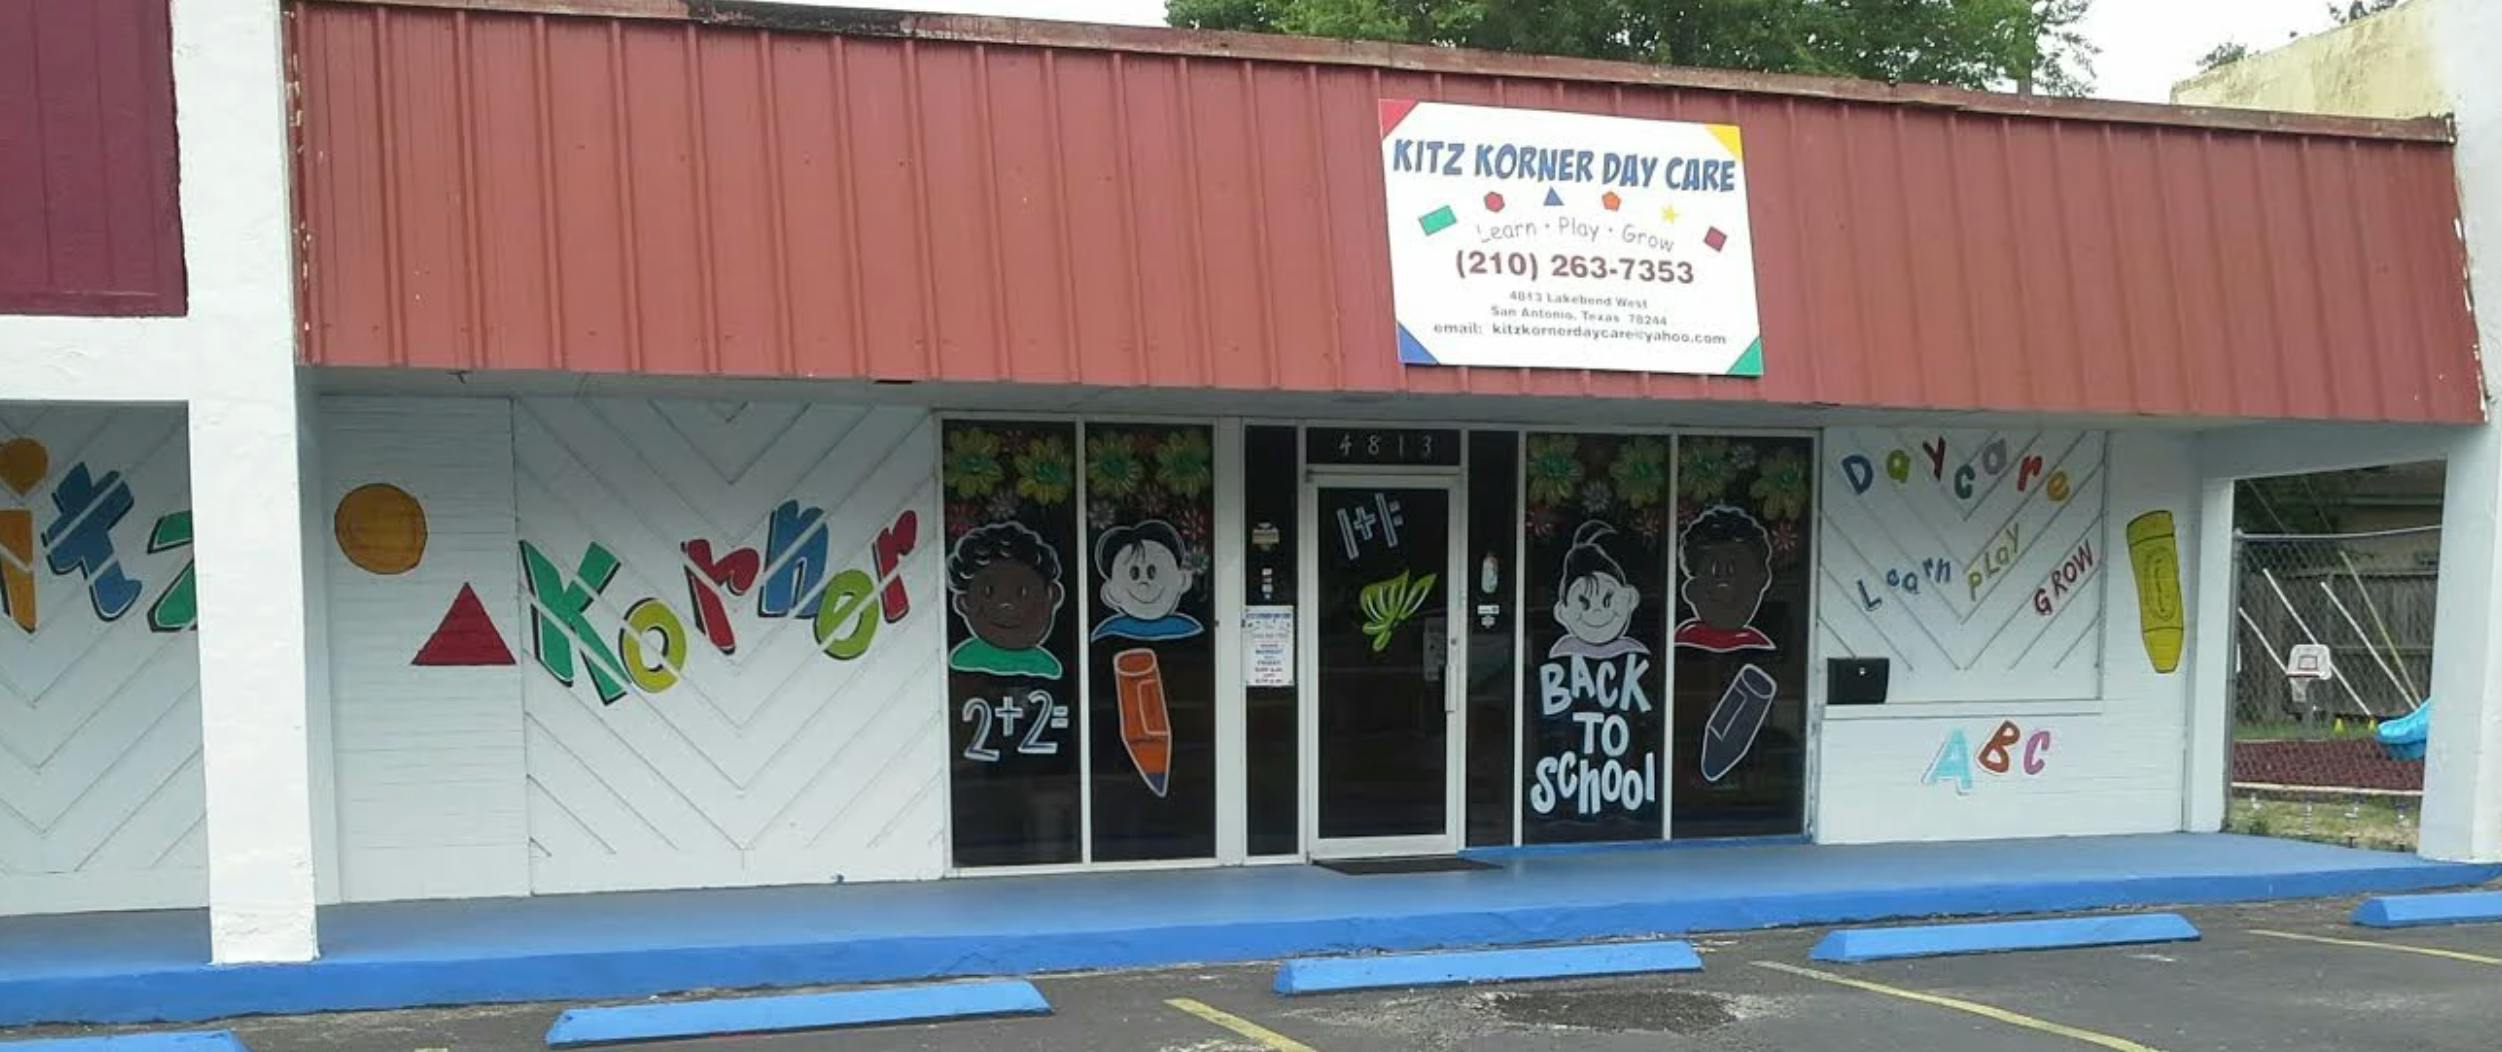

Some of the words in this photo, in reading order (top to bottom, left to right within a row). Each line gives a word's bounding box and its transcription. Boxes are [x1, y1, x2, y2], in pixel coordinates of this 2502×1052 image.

[1393, 138, 1466, 176] KITZ
[1474, 143, 1594, 183] KORNER
[1602, 153, 1659, 189] DAY
[1665, 157, 1736, 192] CARE
[1476, 220, 1537, 243] Learn
[1558, 216, 1600, 243] Play
[1621, 223, 1675, 252] Grow
[1456, 250, 1539, 281] (210)
[1551, 253, 1695, 285] 263-7353
[1490, 305, 1517, 317] San
[1582, 310, 1620, 323] Texas
[1547, 292, 1612, 307] Lakebend
[1617, 296, 1648, 309] West
[1433, 321, 1483, 335] email:
[1339, 434, 1434, 456] 4813
[2034, 538, 2093, 615] GROW
[519, 500, 918, 706] Korner
[1539, 653, 1652, 715] BACK
[1572, 711, 1630, 756] TO
